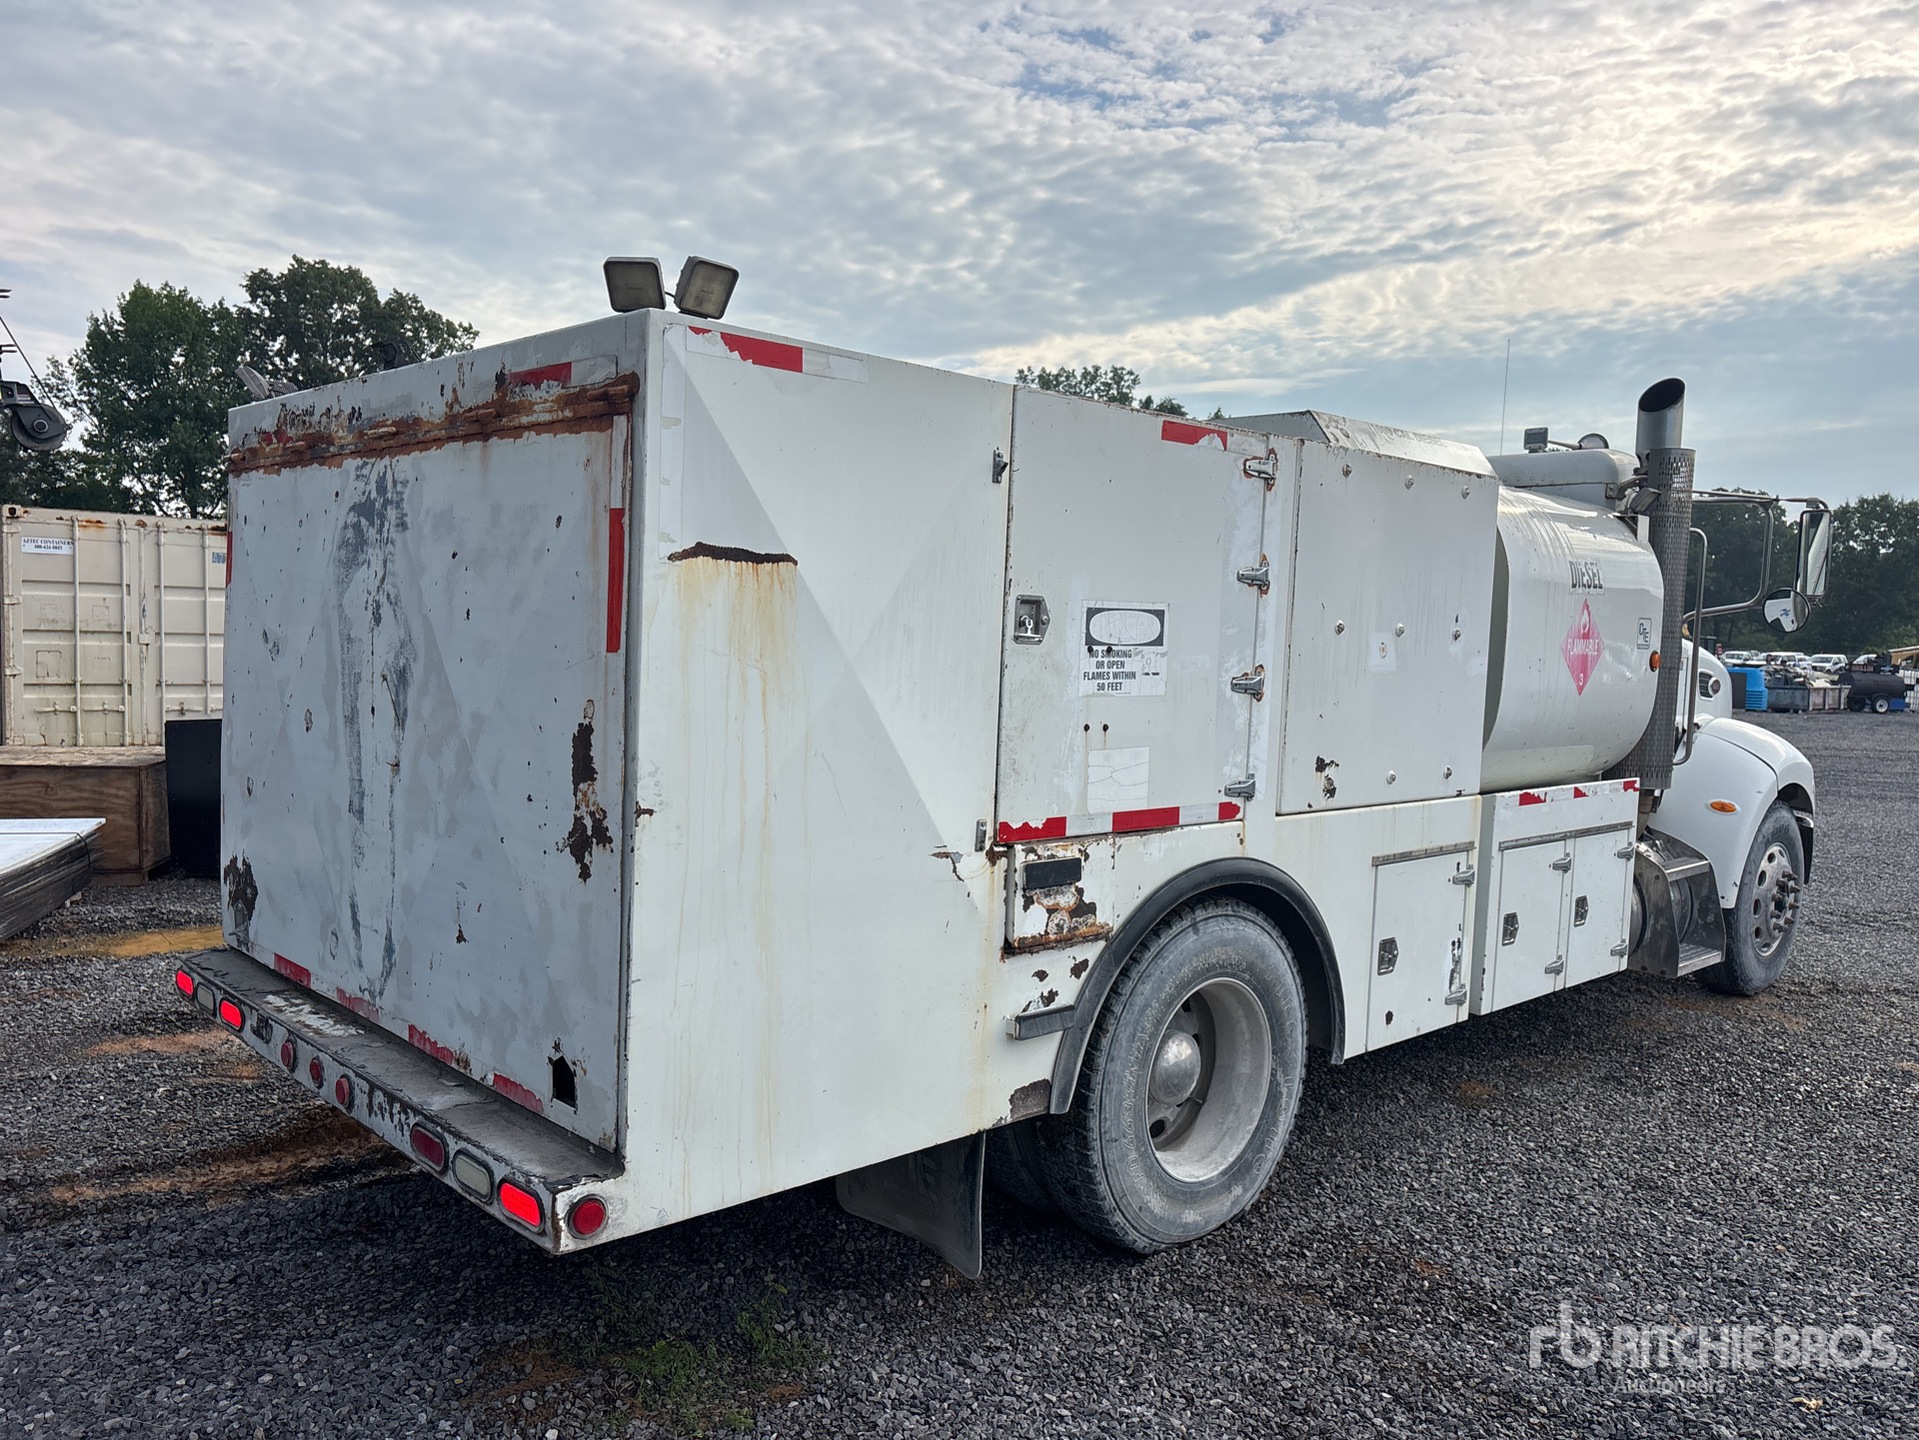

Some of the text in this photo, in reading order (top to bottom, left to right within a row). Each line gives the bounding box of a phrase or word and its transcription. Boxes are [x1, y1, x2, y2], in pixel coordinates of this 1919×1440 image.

[1568, 560, 1603, 590] DIESEL
[1567, 638, 1599, 656] FLAMMABLE
[1088, 648, 1099, 659] NO
[1095, 660, 1125, 670] OR OPEN
[1083, 671, 1110, 681] FLAMES
[1112, 671, 1137, 680] WITHIN
[1578, 672, 1584, 686] 3
[1096, 681, 1123, 692] 50 FEET
